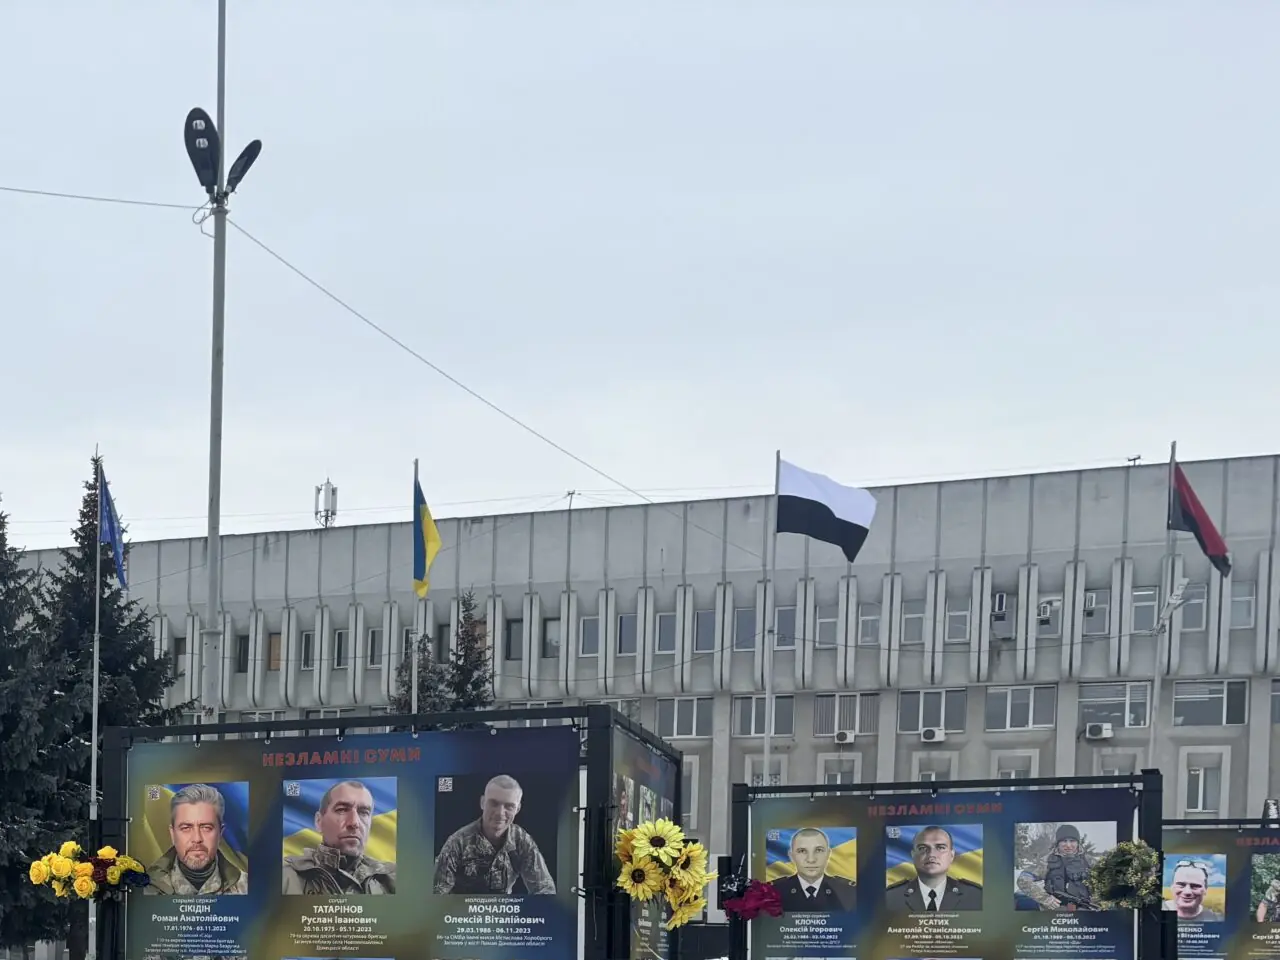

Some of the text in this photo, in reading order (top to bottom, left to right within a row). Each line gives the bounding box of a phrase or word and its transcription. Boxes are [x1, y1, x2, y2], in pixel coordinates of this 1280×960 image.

[262, 746, 421, 767] НЕЗЛАМНІ СУМИ
[868, 803, 951, 817] НЕЗЛАМНІ
[179, 904, 211, 914] СІКІДІН
[313, 905, 364, 914] ТАТАРІНОВ
[468, 904, 521, 914] МОЧАЛОВ
[152, 914, 240, 923] Роман Анатолійович
[301, 915, 377, 925] Руслан Іванович
[444, 914, 546, 924] Олексій Віталійович
[809, 926, 843, 934] Ігорович
[923, 926, 982, 934] Станіславович
[1022, 925, 1049, 934] Сергій
